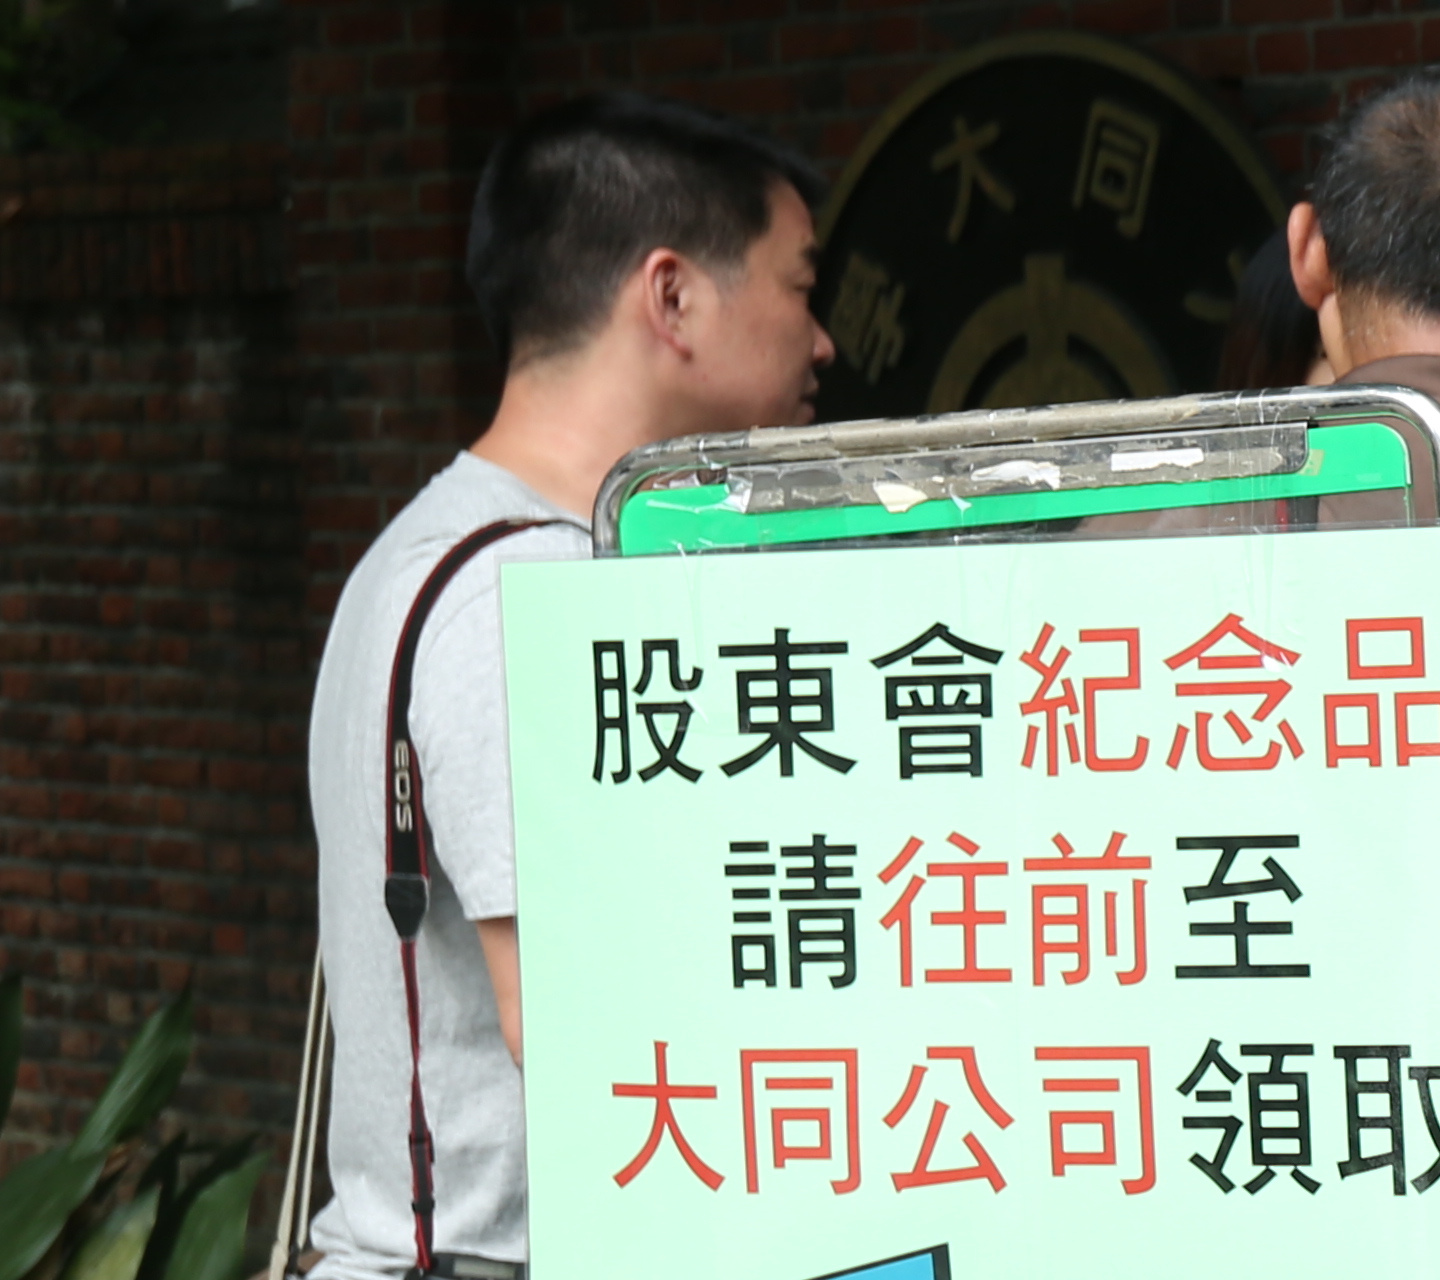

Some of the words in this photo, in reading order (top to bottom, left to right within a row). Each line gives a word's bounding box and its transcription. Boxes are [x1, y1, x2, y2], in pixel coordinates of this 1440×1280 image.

[394, 739, 413, 833] EOS
[722, 831, 1313, 990] 請往前至
